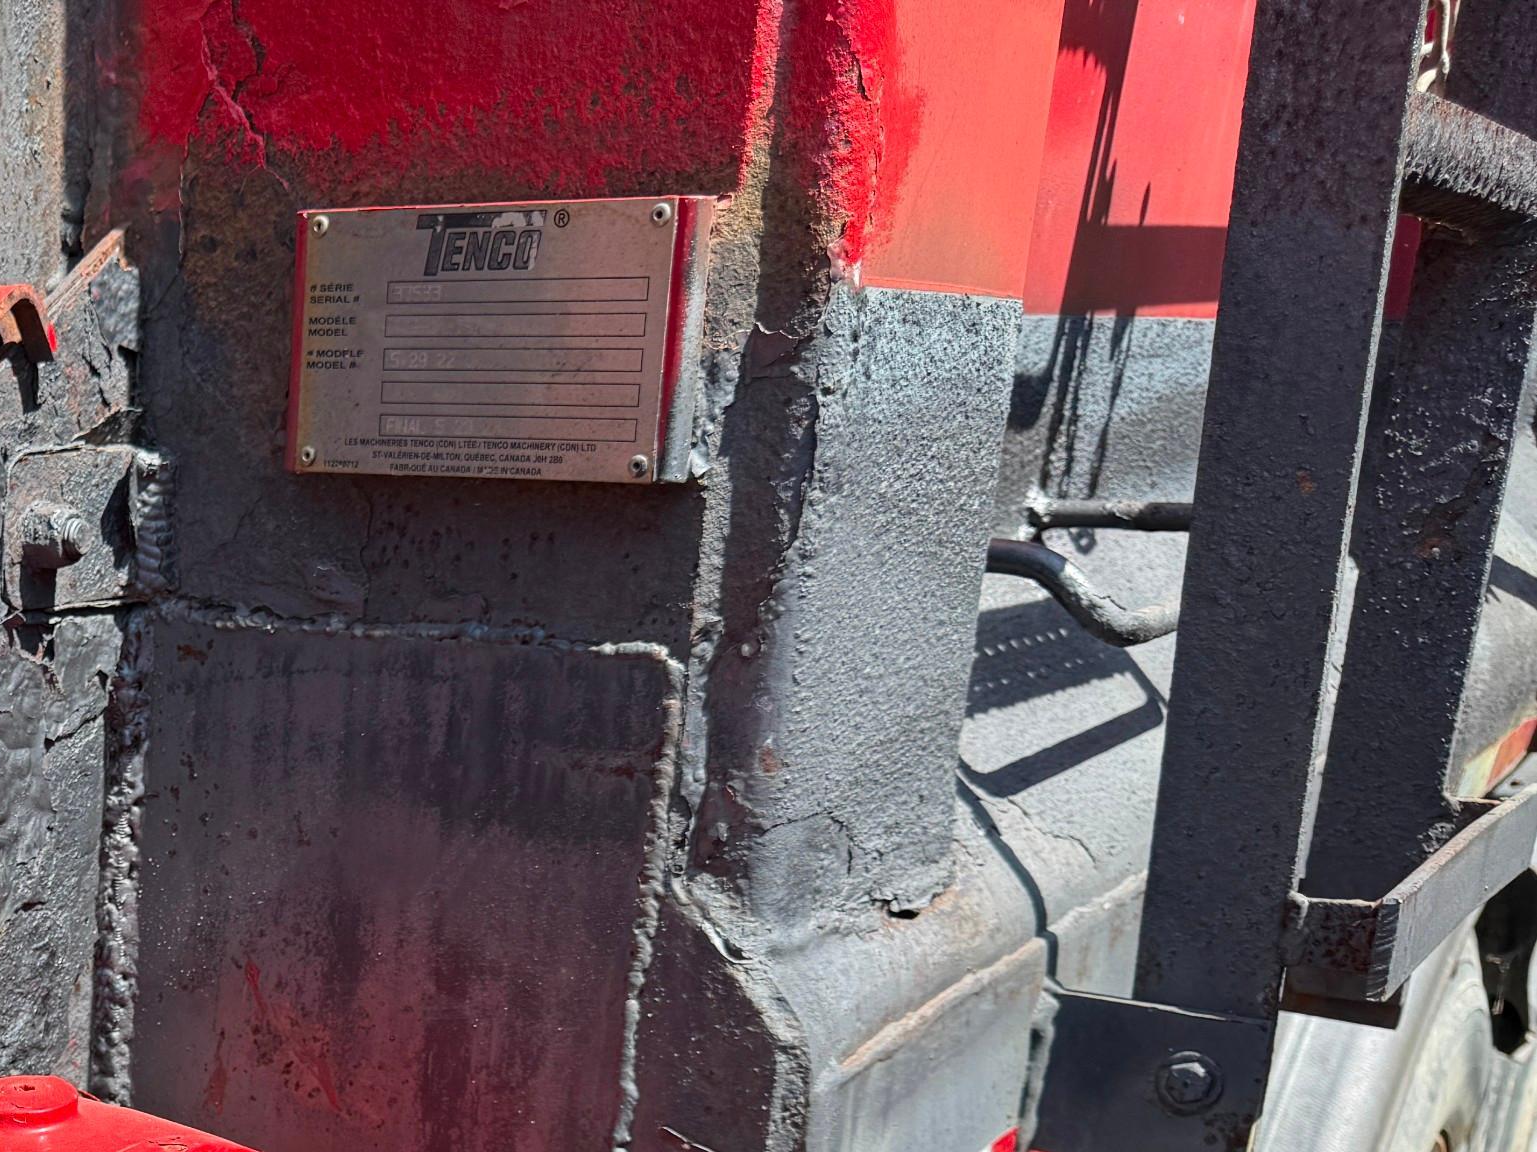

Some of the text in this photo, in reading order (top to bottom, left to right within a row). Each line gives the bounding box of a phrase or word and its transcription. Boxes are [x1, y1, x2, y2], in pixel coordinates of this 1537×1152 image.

[416, 209, 548, 277] TENCO
[310, 295, 350, 304] SERIAL
[308, 328, 348, 337] MODEL
[306, 361, 346, 370] MODEL
[410, 439, 434, 448] TENCO
[482, 440, 509, 450] TENCO
[509, 441, 556, 451] MACHINERY
[499, 454, 531, 463] CANADA
